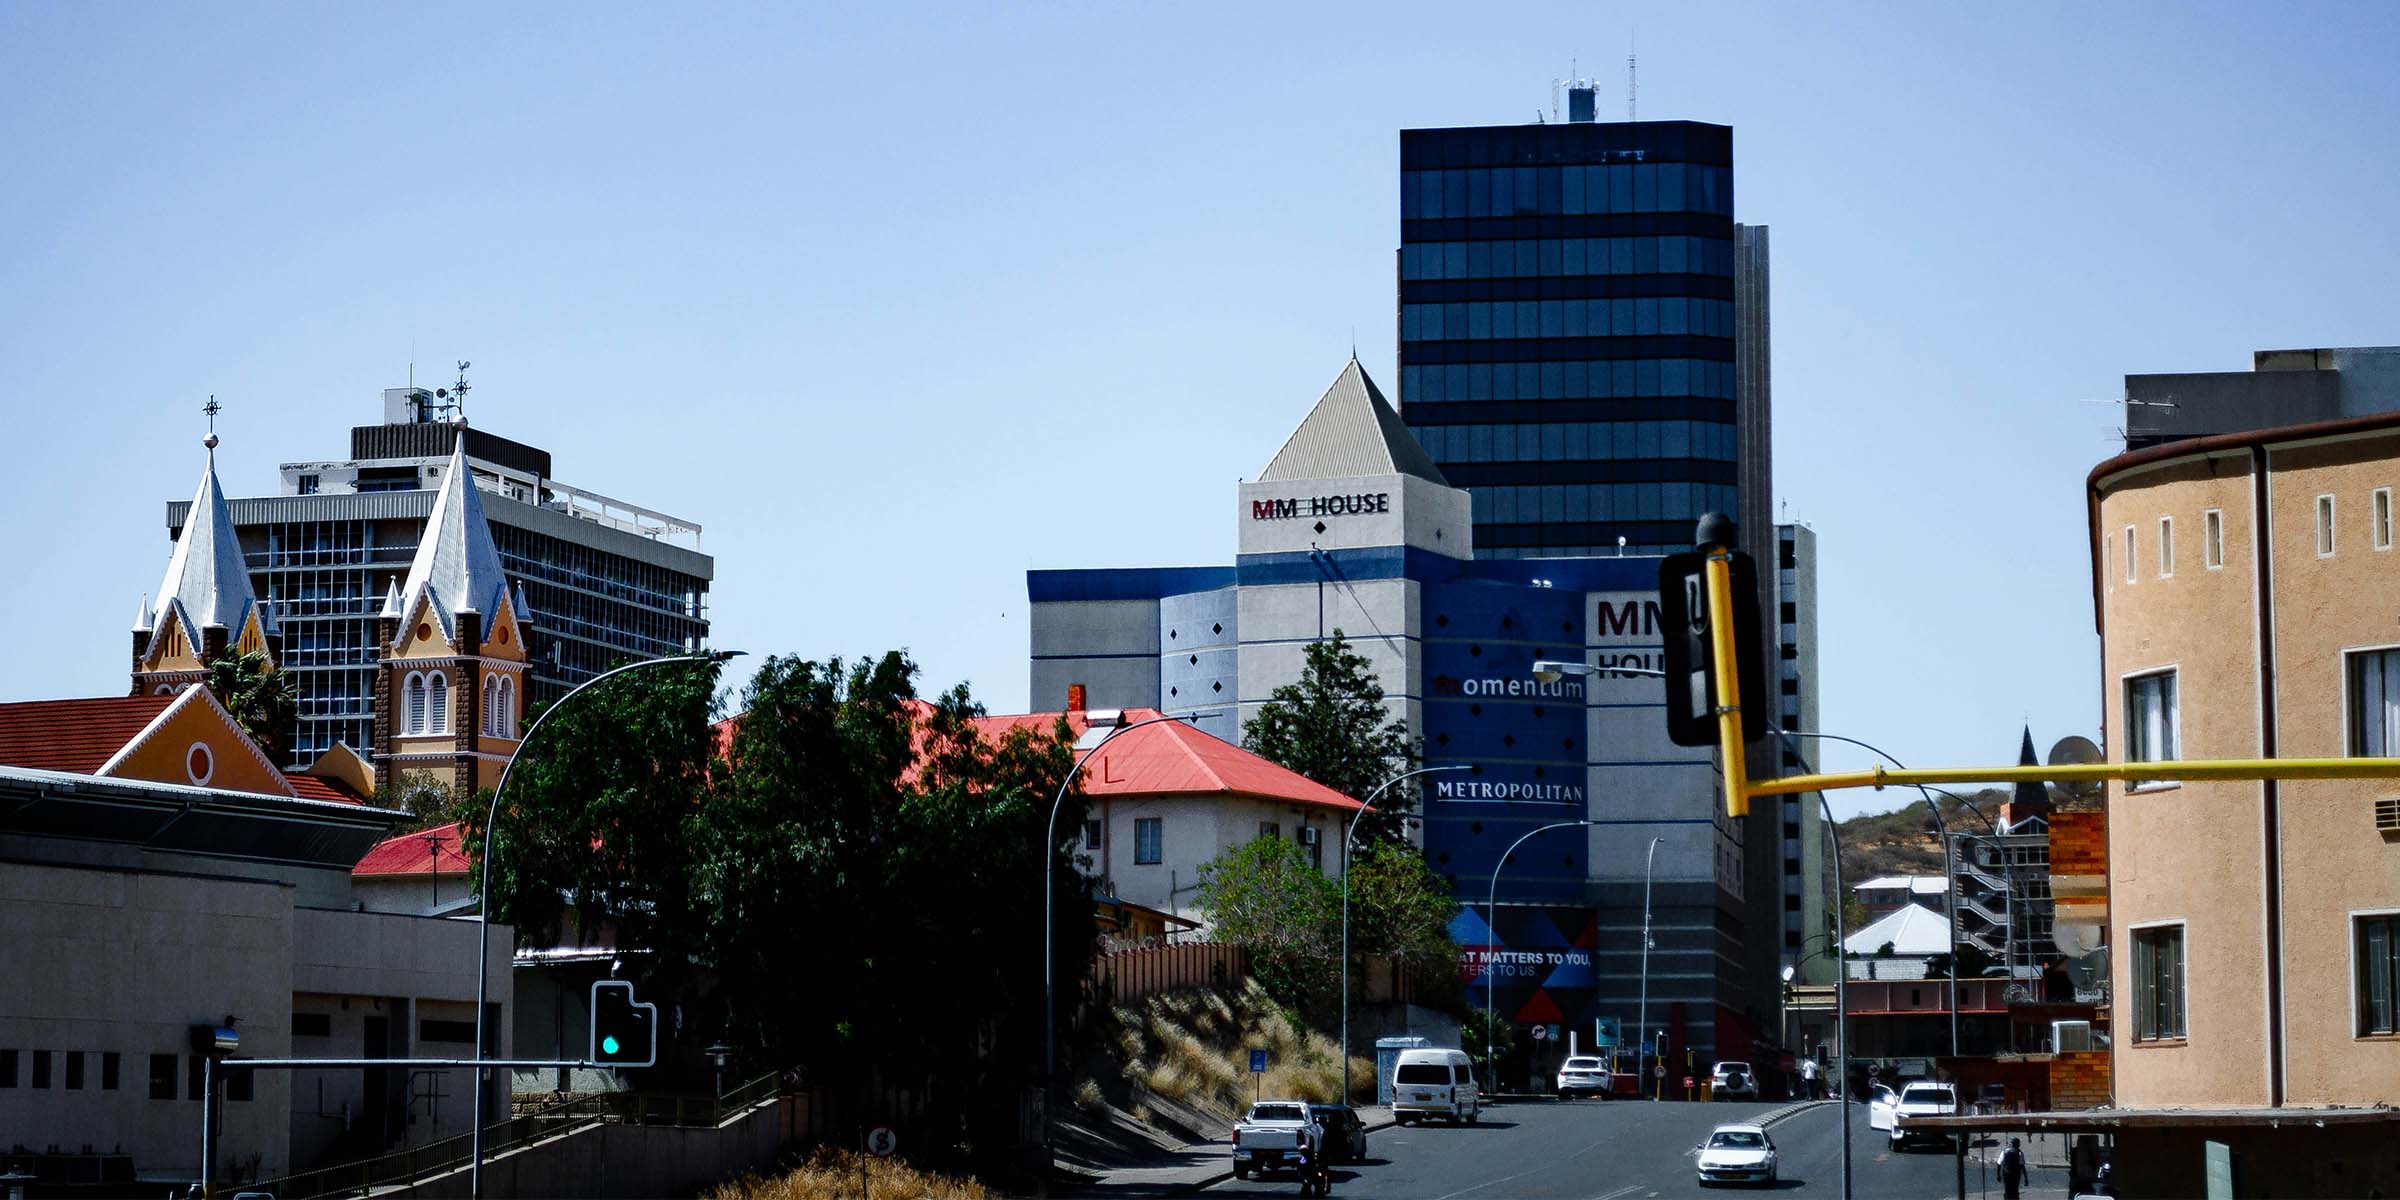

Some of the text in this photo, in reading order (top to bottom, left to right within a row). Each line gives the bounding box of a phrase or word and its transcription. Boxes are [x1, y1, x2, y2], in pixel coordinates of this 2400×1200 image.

[1252, 493, 1389, 520] MM HOUSE
[1599, 654, 1665, 679] HOU
[1437, 781, 1583, 801] METROPOLITAN
[1457, 951, 1477, 963] AT
[1480, 952, 1544, 964] MATTERS
[1546, 953, 1563, 965] TO
[1461, 964, 1495, 977] TERS
[1498, 965, 1515, 976] TO
